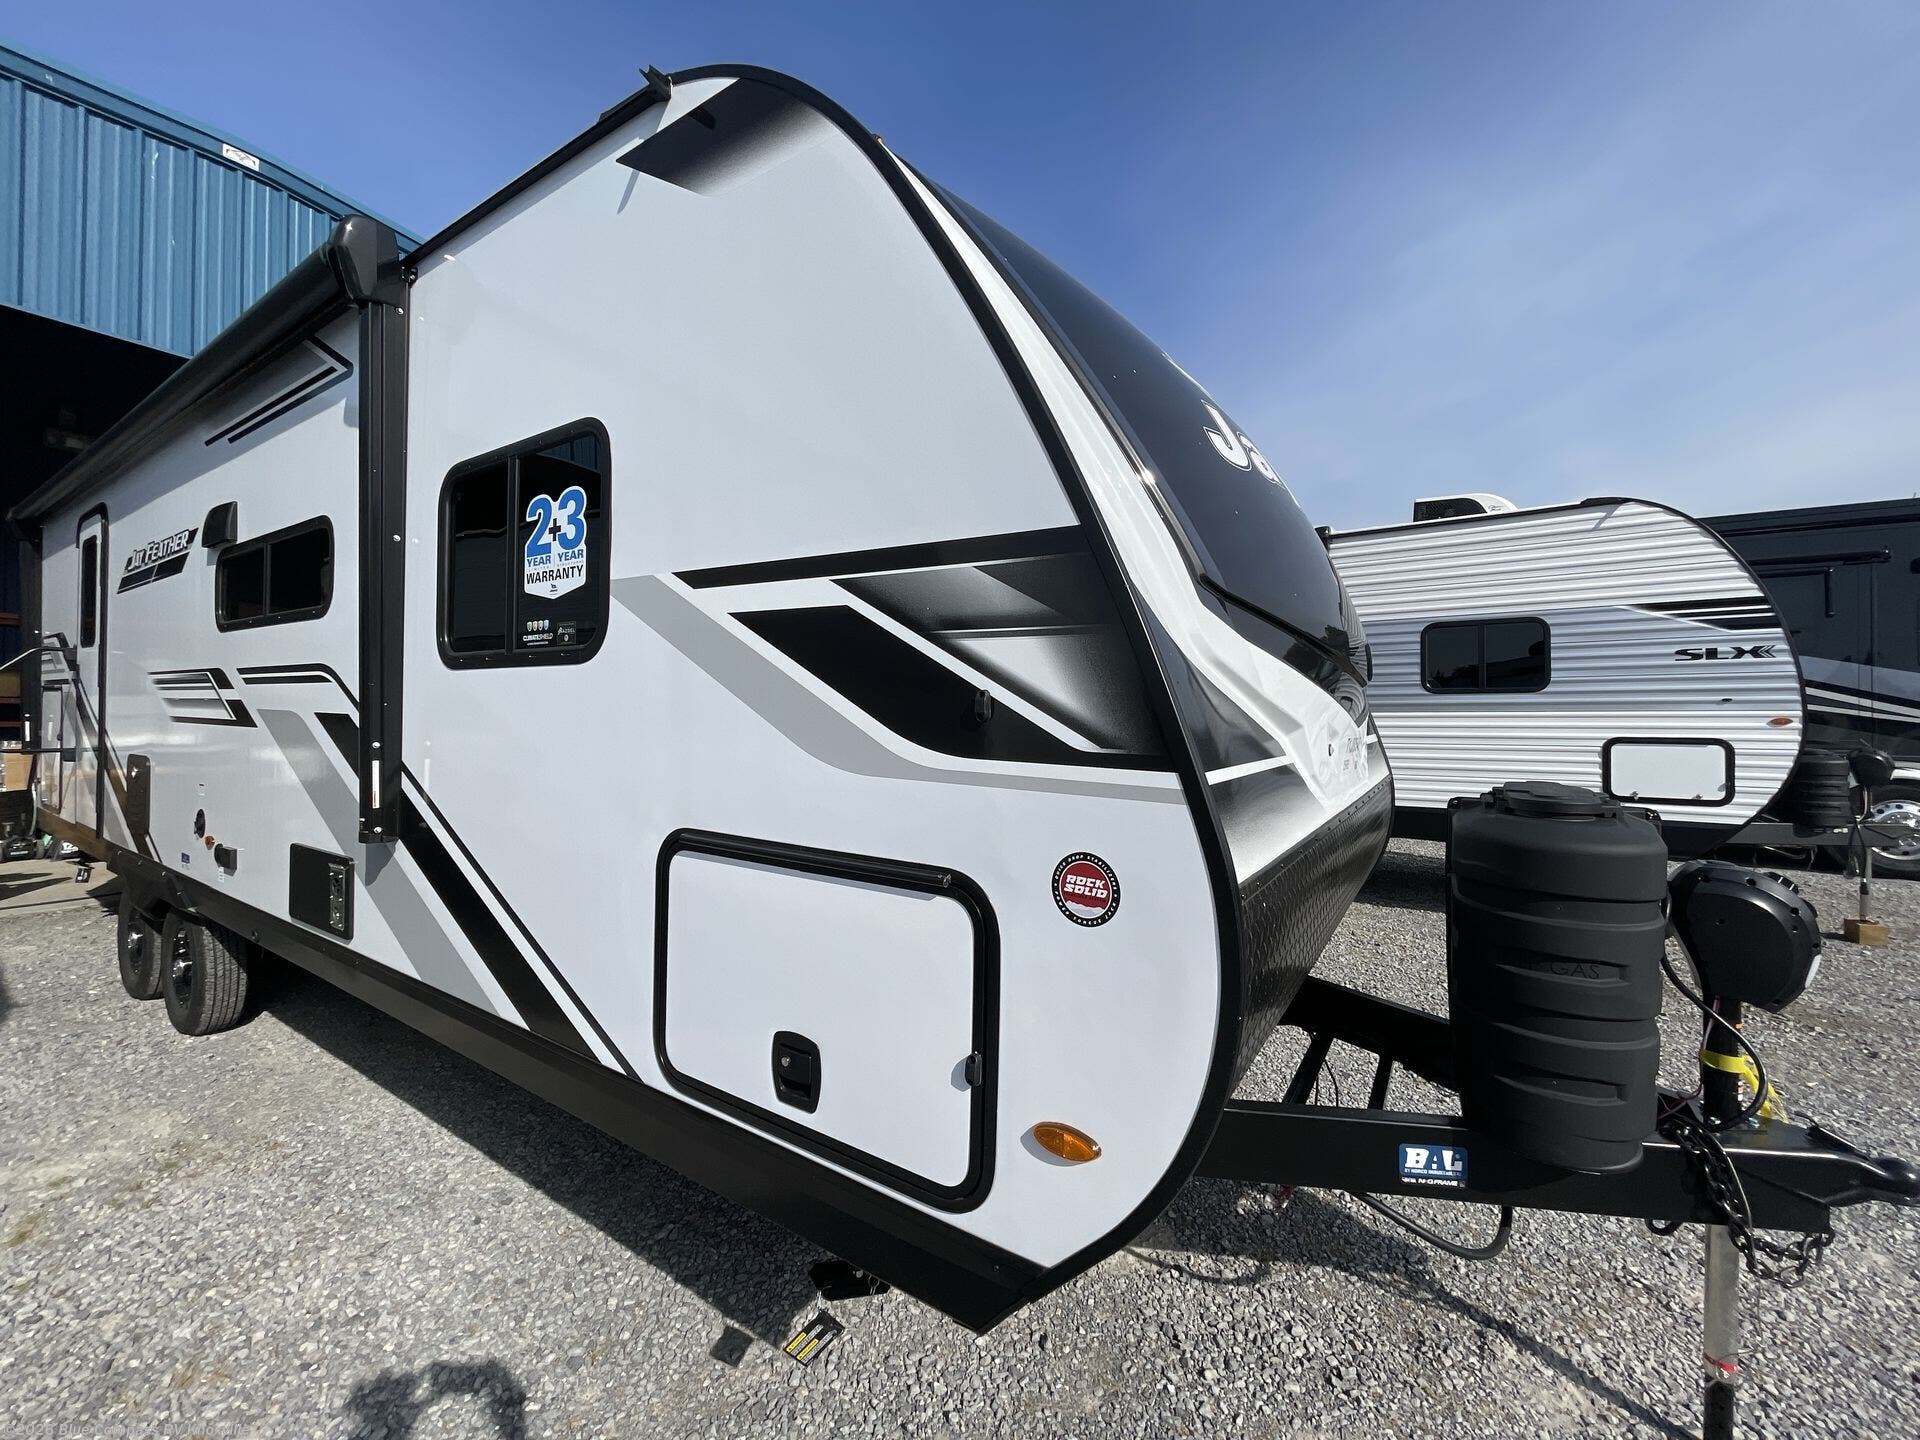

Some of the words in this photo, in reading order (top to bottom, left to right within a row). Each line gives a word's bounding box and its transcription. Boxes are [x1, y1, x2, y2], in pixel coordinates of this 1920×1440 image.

[1200, 400, 1283, 485] Ja
[145, 530, 189, 564] FEATHER
[527, 555, 552, 568] YEAR
[558, 549, 584, 562] YEAR
[526, 564, 584, 585] WARRANTY
[1674, 645, 1776, 661] SLX
[1063, 883, 1109, 899] SOLID
[1066, 874, 1106, 889] ROCK
[1405, 1147, 1463, 1172] BAL
